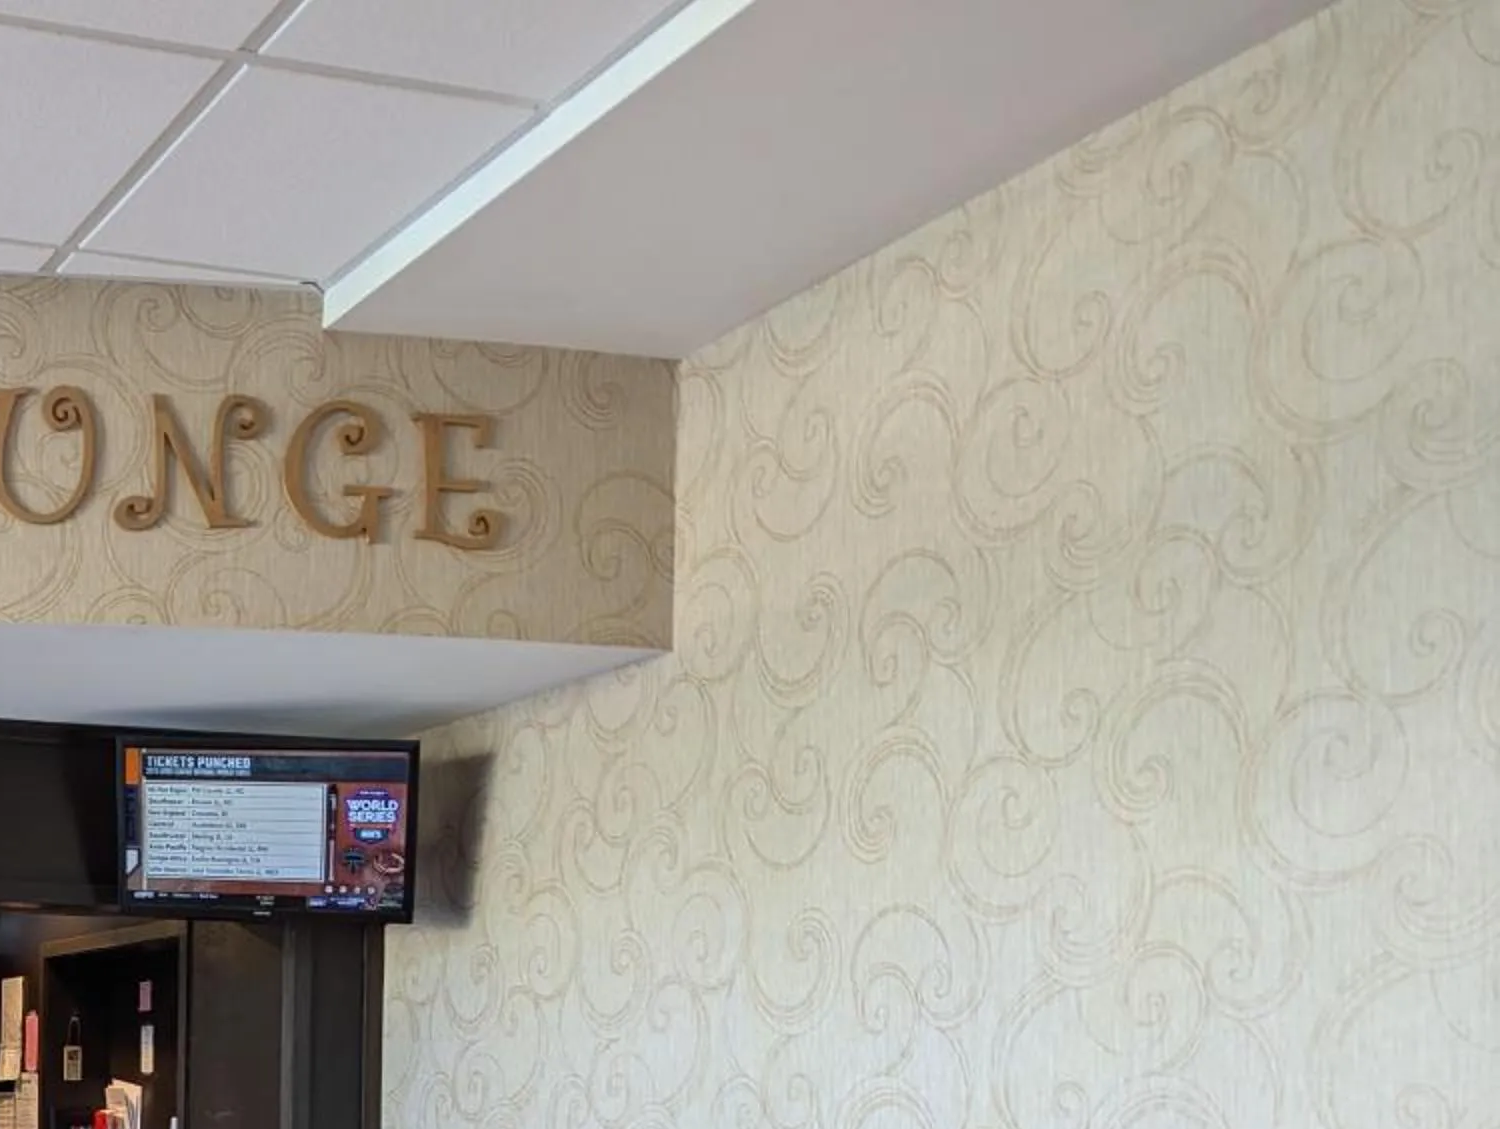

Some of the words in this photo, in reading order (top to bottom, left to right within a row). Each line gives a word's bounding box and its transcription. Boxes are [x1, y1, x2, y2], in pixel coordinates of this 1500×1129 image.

[147, 755, 195, 768] TICKETS
[197, 756, 251, 769] PUNCHED
[345, 799, 399, 811] WORLD
[347, 811, 397, 823] SERIES
